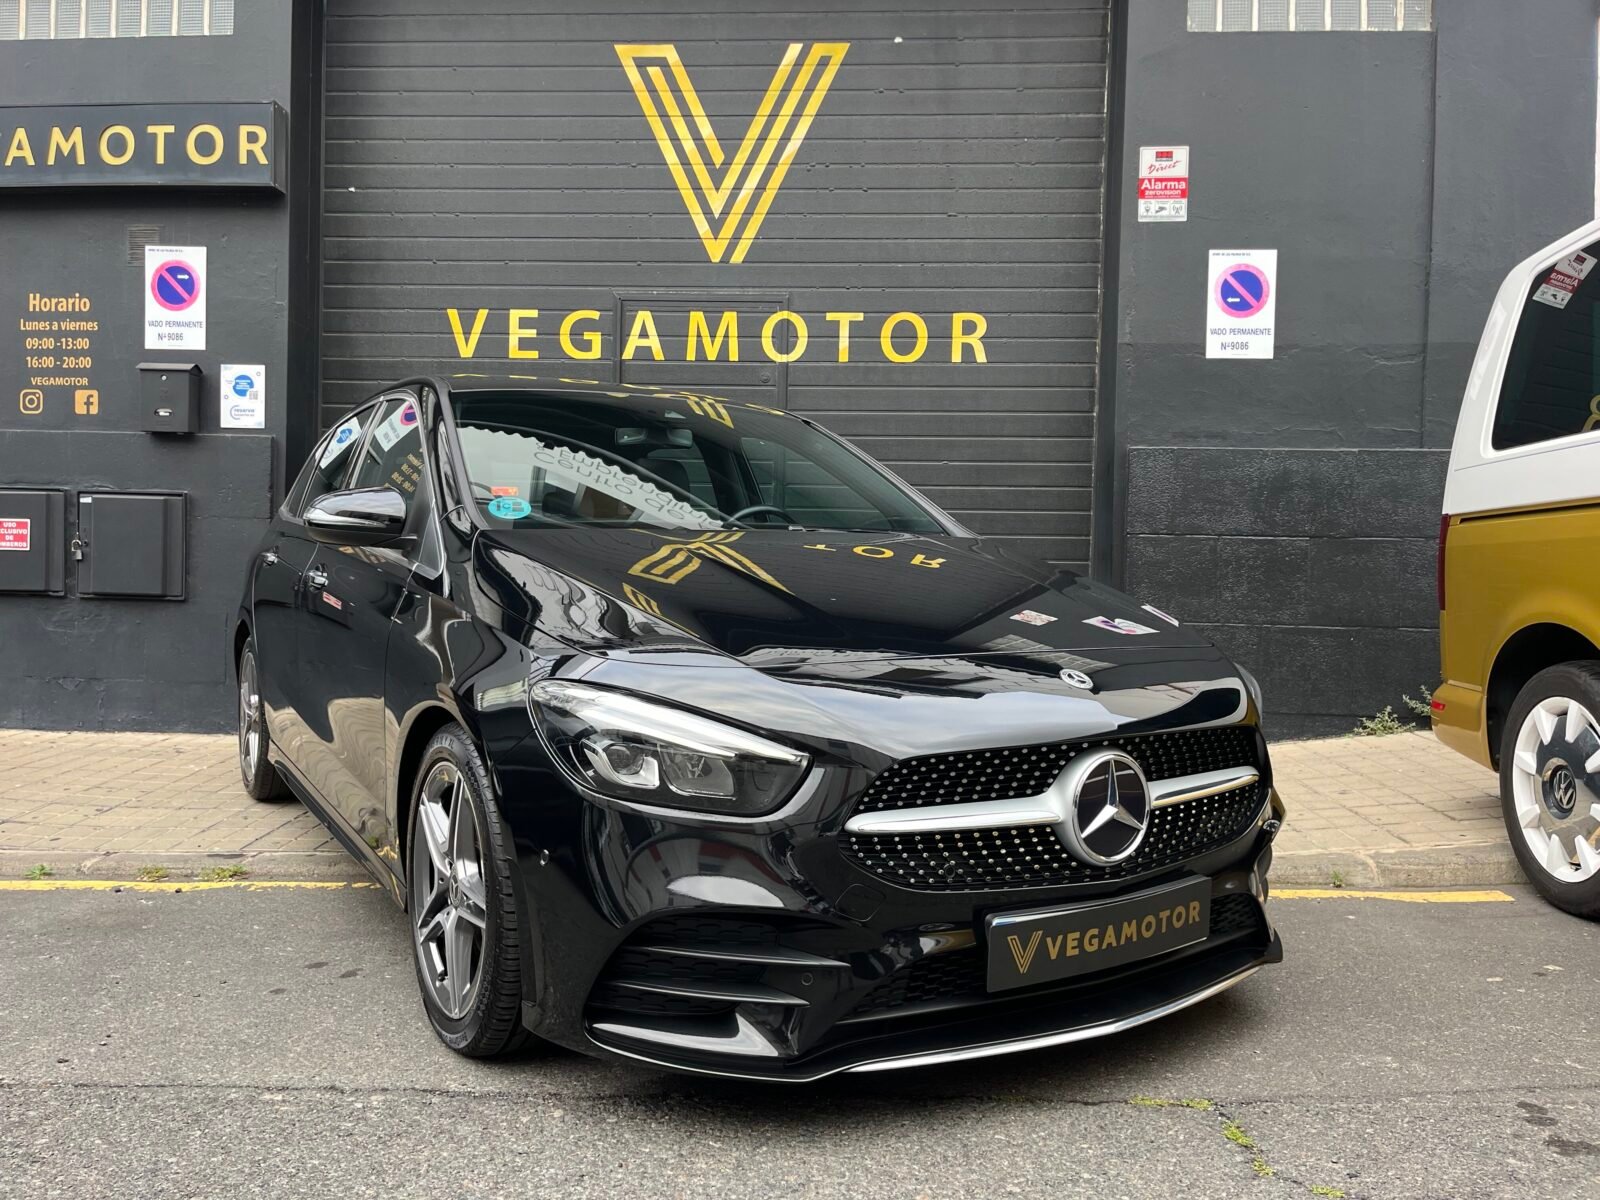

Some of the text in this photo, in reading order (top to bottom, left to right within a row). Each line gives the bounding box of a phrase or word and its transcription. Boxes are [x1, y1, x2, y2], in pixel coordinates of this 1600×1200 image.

[0, 124, 269, 166] AMOTOR
[1140, 179, 1186, 190] Alarma
[28, 292, 91, 312] Horario
[20, 318, 98, 331] Lunes a viernes
[148, 320, 203, 329] VADO PERMANENTE
[446, 308, 989, 364] VEGAMOTOR
[1210, 327, 1272, 336] VADO PERMANENTE
[25, 337, 55, 350] 09:00
[25, 356, 55, 368] 16:00
[62, 356, 92, 368] 20:00
[30, 376, 89, 386] VEGAMOTOR
[1045, 900, 1201, 961] VEGAMOTOR
